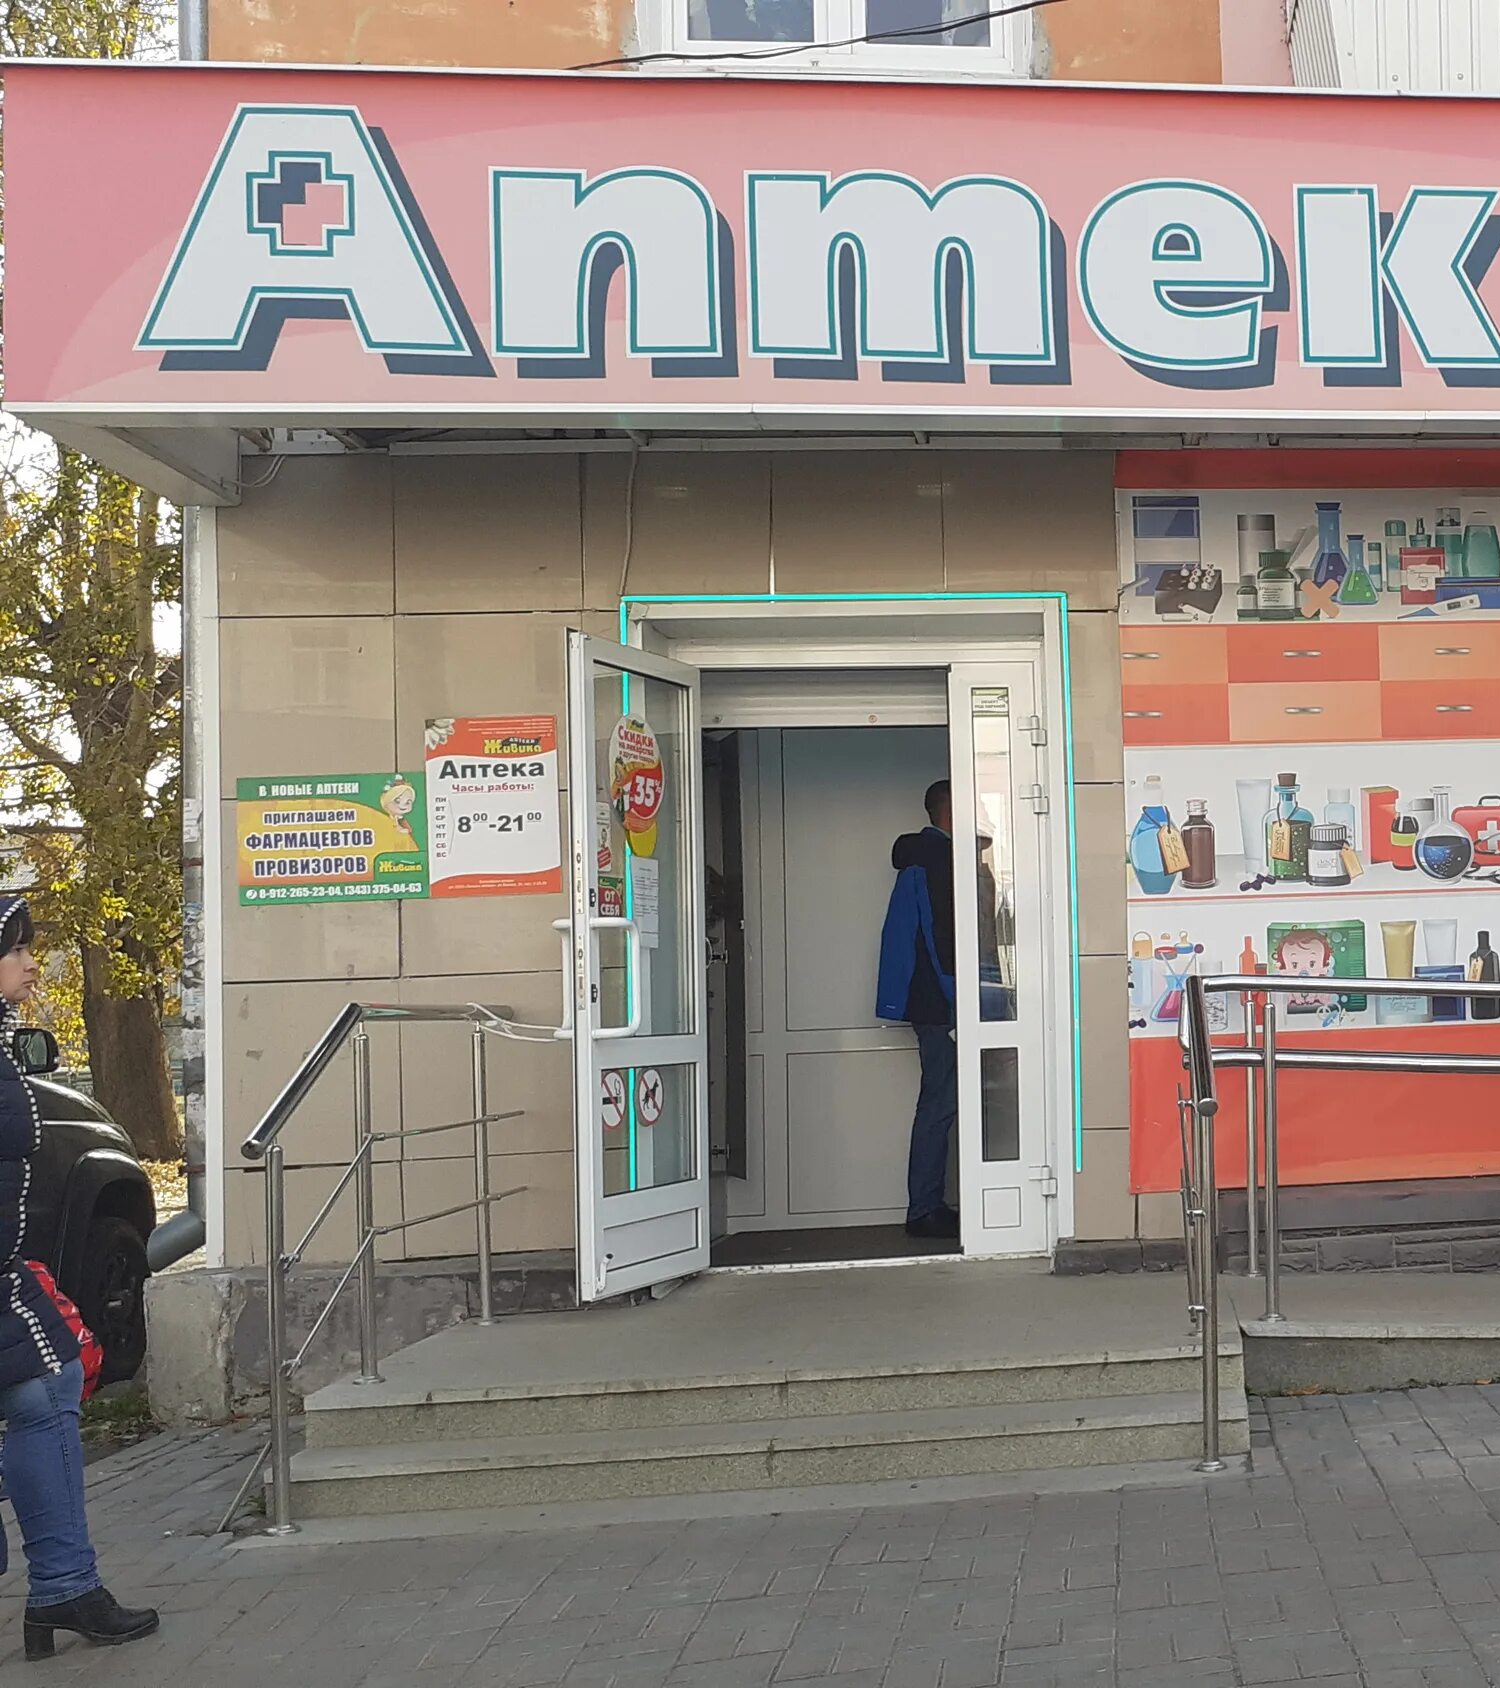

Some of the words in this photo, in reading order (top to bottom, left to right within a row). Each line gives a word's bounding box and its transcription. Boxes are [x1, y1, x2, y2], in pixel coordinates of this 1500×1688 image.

[439, 760, 545, 779] Аптека
[258, 785, 268, 796] В
[271, 783, 313, 796] НОВЫЕ
[316, 782, 360, 795] АПТЕКИ
[451, 783, 484, 793] Часы
[487, 782, 535, 793] работы:
[264, 810, 356, 825] приглашаем
[246, 830, 373, 849] ФАРМАЦЕВТОВ
[255, 857, 367, 876] ПРОВИЗОРОВ
[604, 890, 616, 903] ОТ
[600, 903, 620, 916] СЕБЯ
